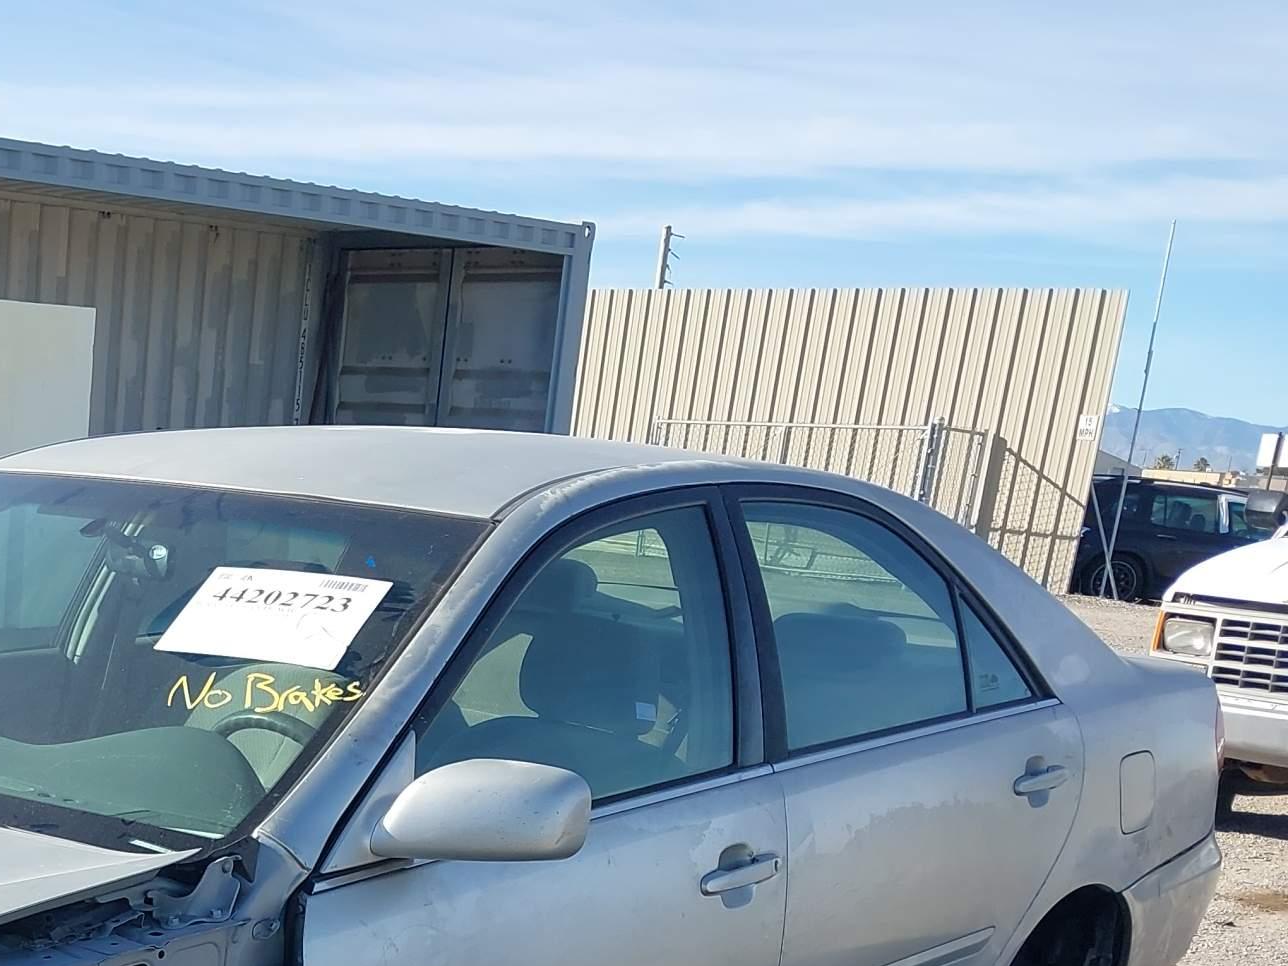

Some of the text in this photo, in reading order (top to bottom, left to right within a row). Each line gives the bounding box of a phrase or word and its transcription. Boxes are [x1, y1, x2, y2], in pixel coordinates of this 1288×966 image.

[1079, 428, 1095, 437] MPH
[212, 587, 352, 612] 44202723
[167, 671, 232, 710] No
